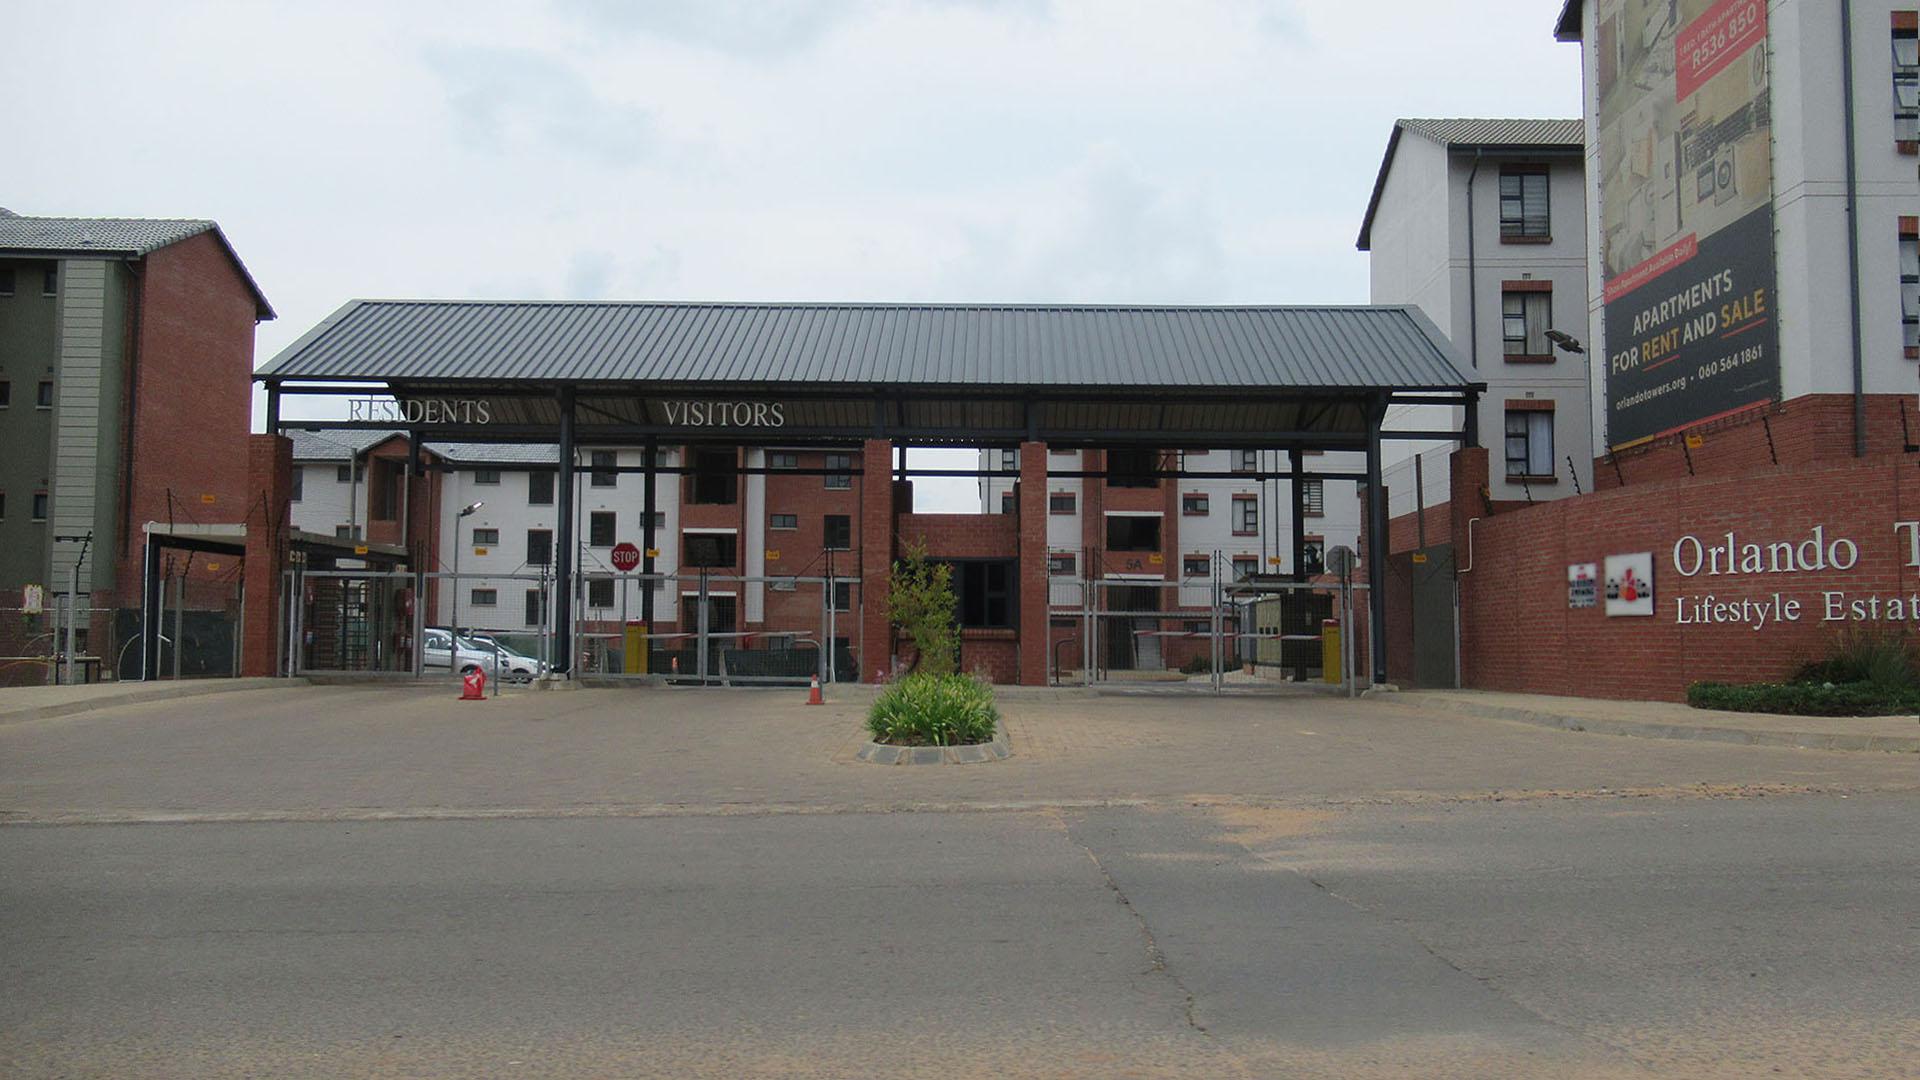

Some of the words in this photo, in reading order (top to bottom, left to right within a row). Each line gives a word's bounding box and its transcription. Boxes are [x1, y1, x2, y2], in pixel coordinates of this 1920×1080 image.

[1692, 28, 1725, 70] R536
[1729, 3, 1756, 39] 850
[1632, 269, 1733, 336] APARTMENTS
[1612, 346, 1639, 375] FOR
[1642, 327, 1680, 362] RENT
[1683, 311, 1717, 345] AND
[1721, 288, 1766, 328] SALE
[1615, 376, 1687, 411] orlandotowers.org
[1698, 361, 1718, 380] 060
[1720, 354, 1738, 372] 564
[1740, 344, 1763, 365] 1861
[348, 399, 490, 424] RESIDENTS
[662, 401, 785, 427] VISITORS
[613, 551, 638, 564] STOP
[1673, 525, 1858, 577] Orlando
[1675, 592, 1801, 631] Lifestyle
